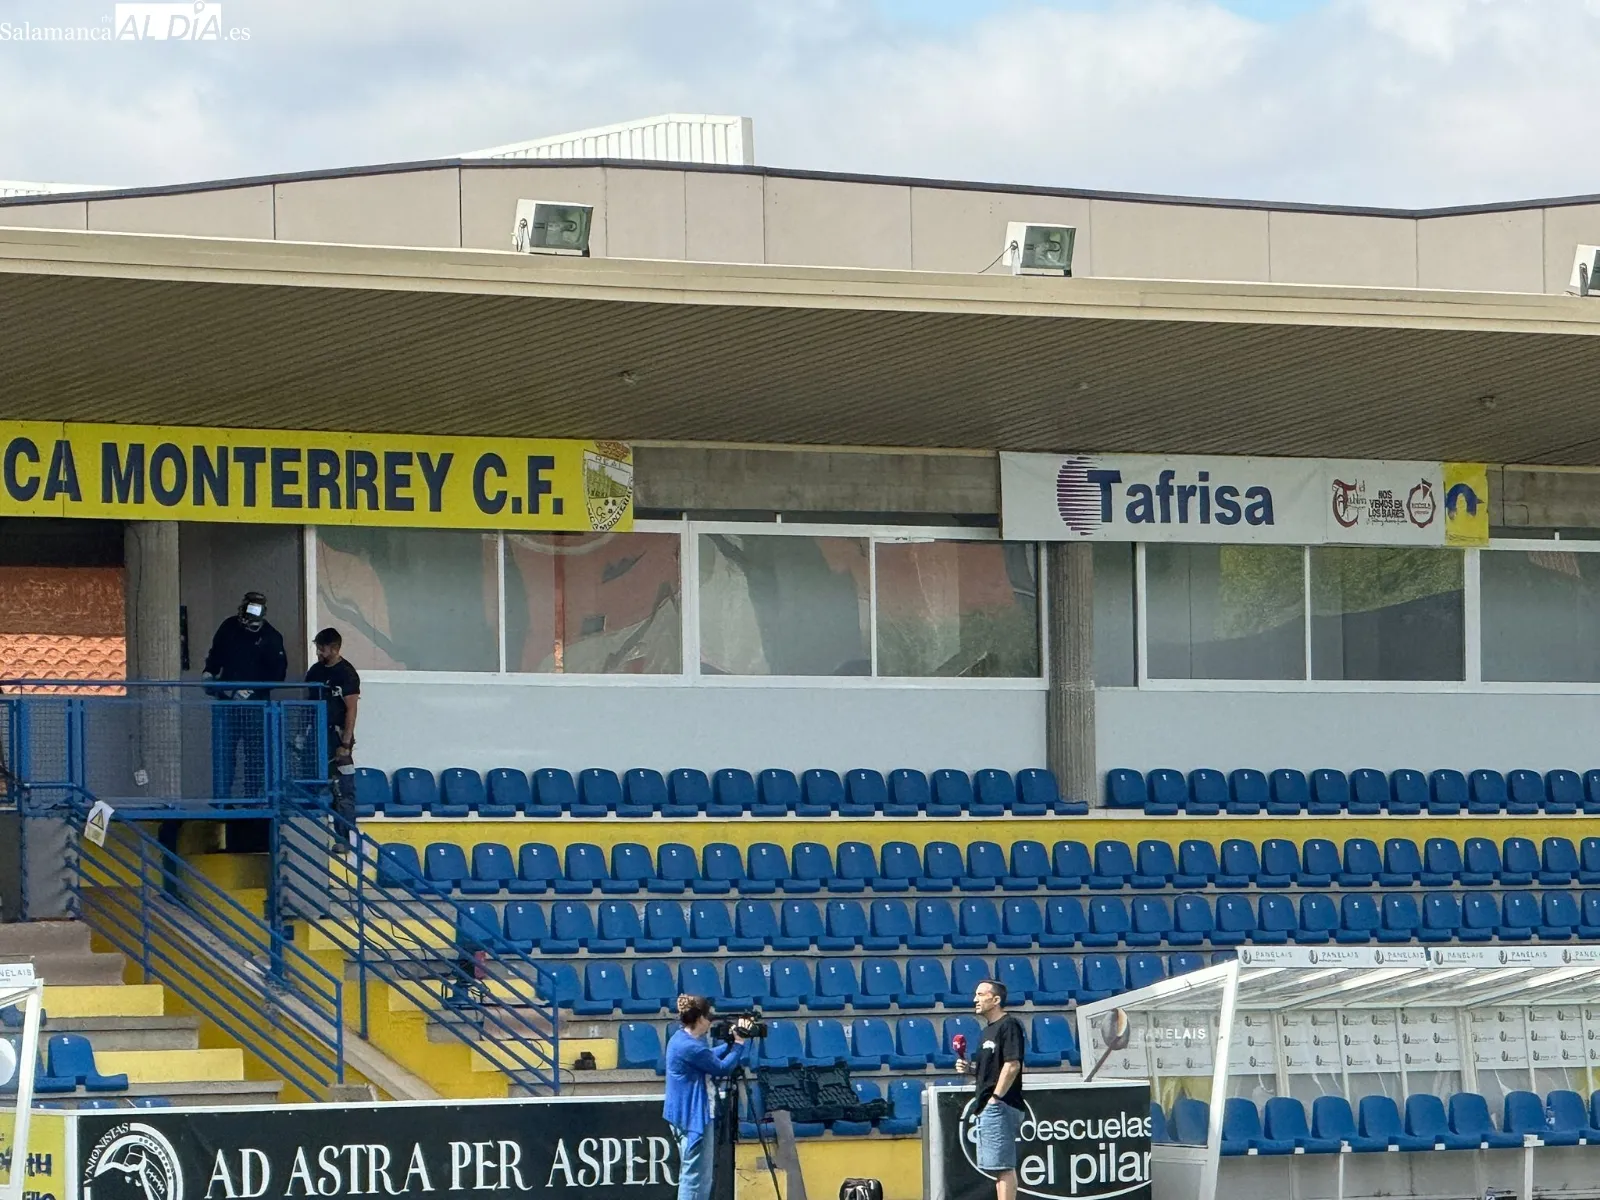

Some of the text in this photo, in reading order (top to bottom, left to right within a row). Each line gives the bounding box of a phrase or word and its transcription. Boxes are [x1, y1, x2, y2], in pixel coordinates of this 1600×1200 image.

[101, 442, 454, 512] MONTERREY
[473, 453, 563, 515] C.F.
[1087, 468, 1275, 526] Tafrisa
[204, 1148, 271, 1199] AD
[284, 1142, 436, 1197] ASTRA
[448, 1139, 534, 1192] PER
[1020, 1145, 1055, 1185] el
